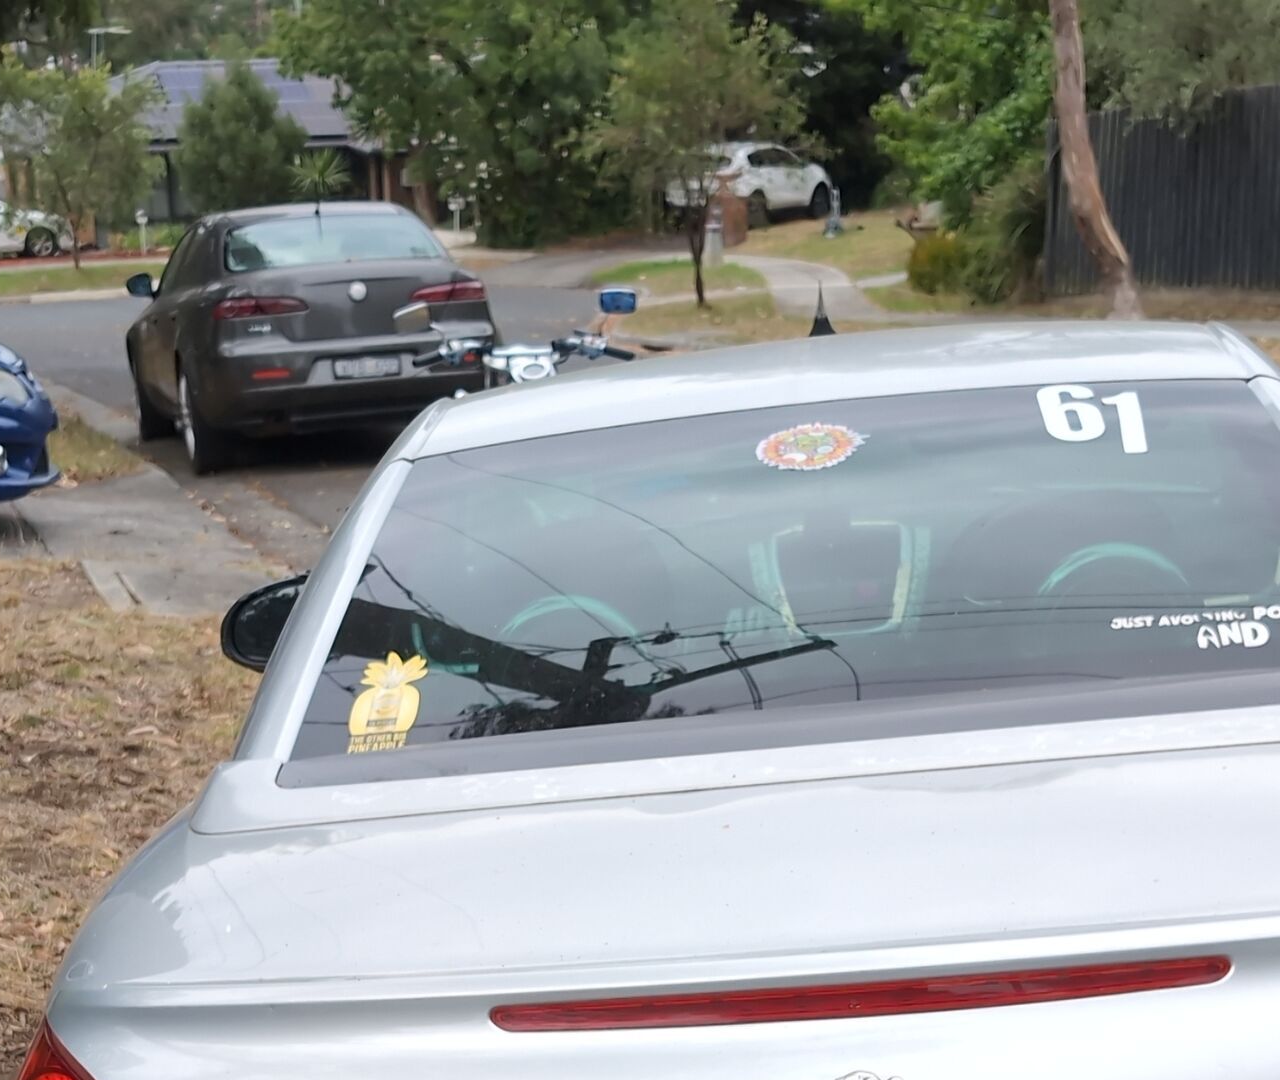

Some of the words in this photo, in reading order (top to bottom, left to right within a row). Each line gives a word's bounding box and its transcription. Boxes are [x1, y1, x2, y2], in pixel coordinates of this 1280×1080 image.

[1035, 384, 1149, 455] 61
[1110, 615, 1154, 630] JUST
[1197, 620, 1270, 649] AND
